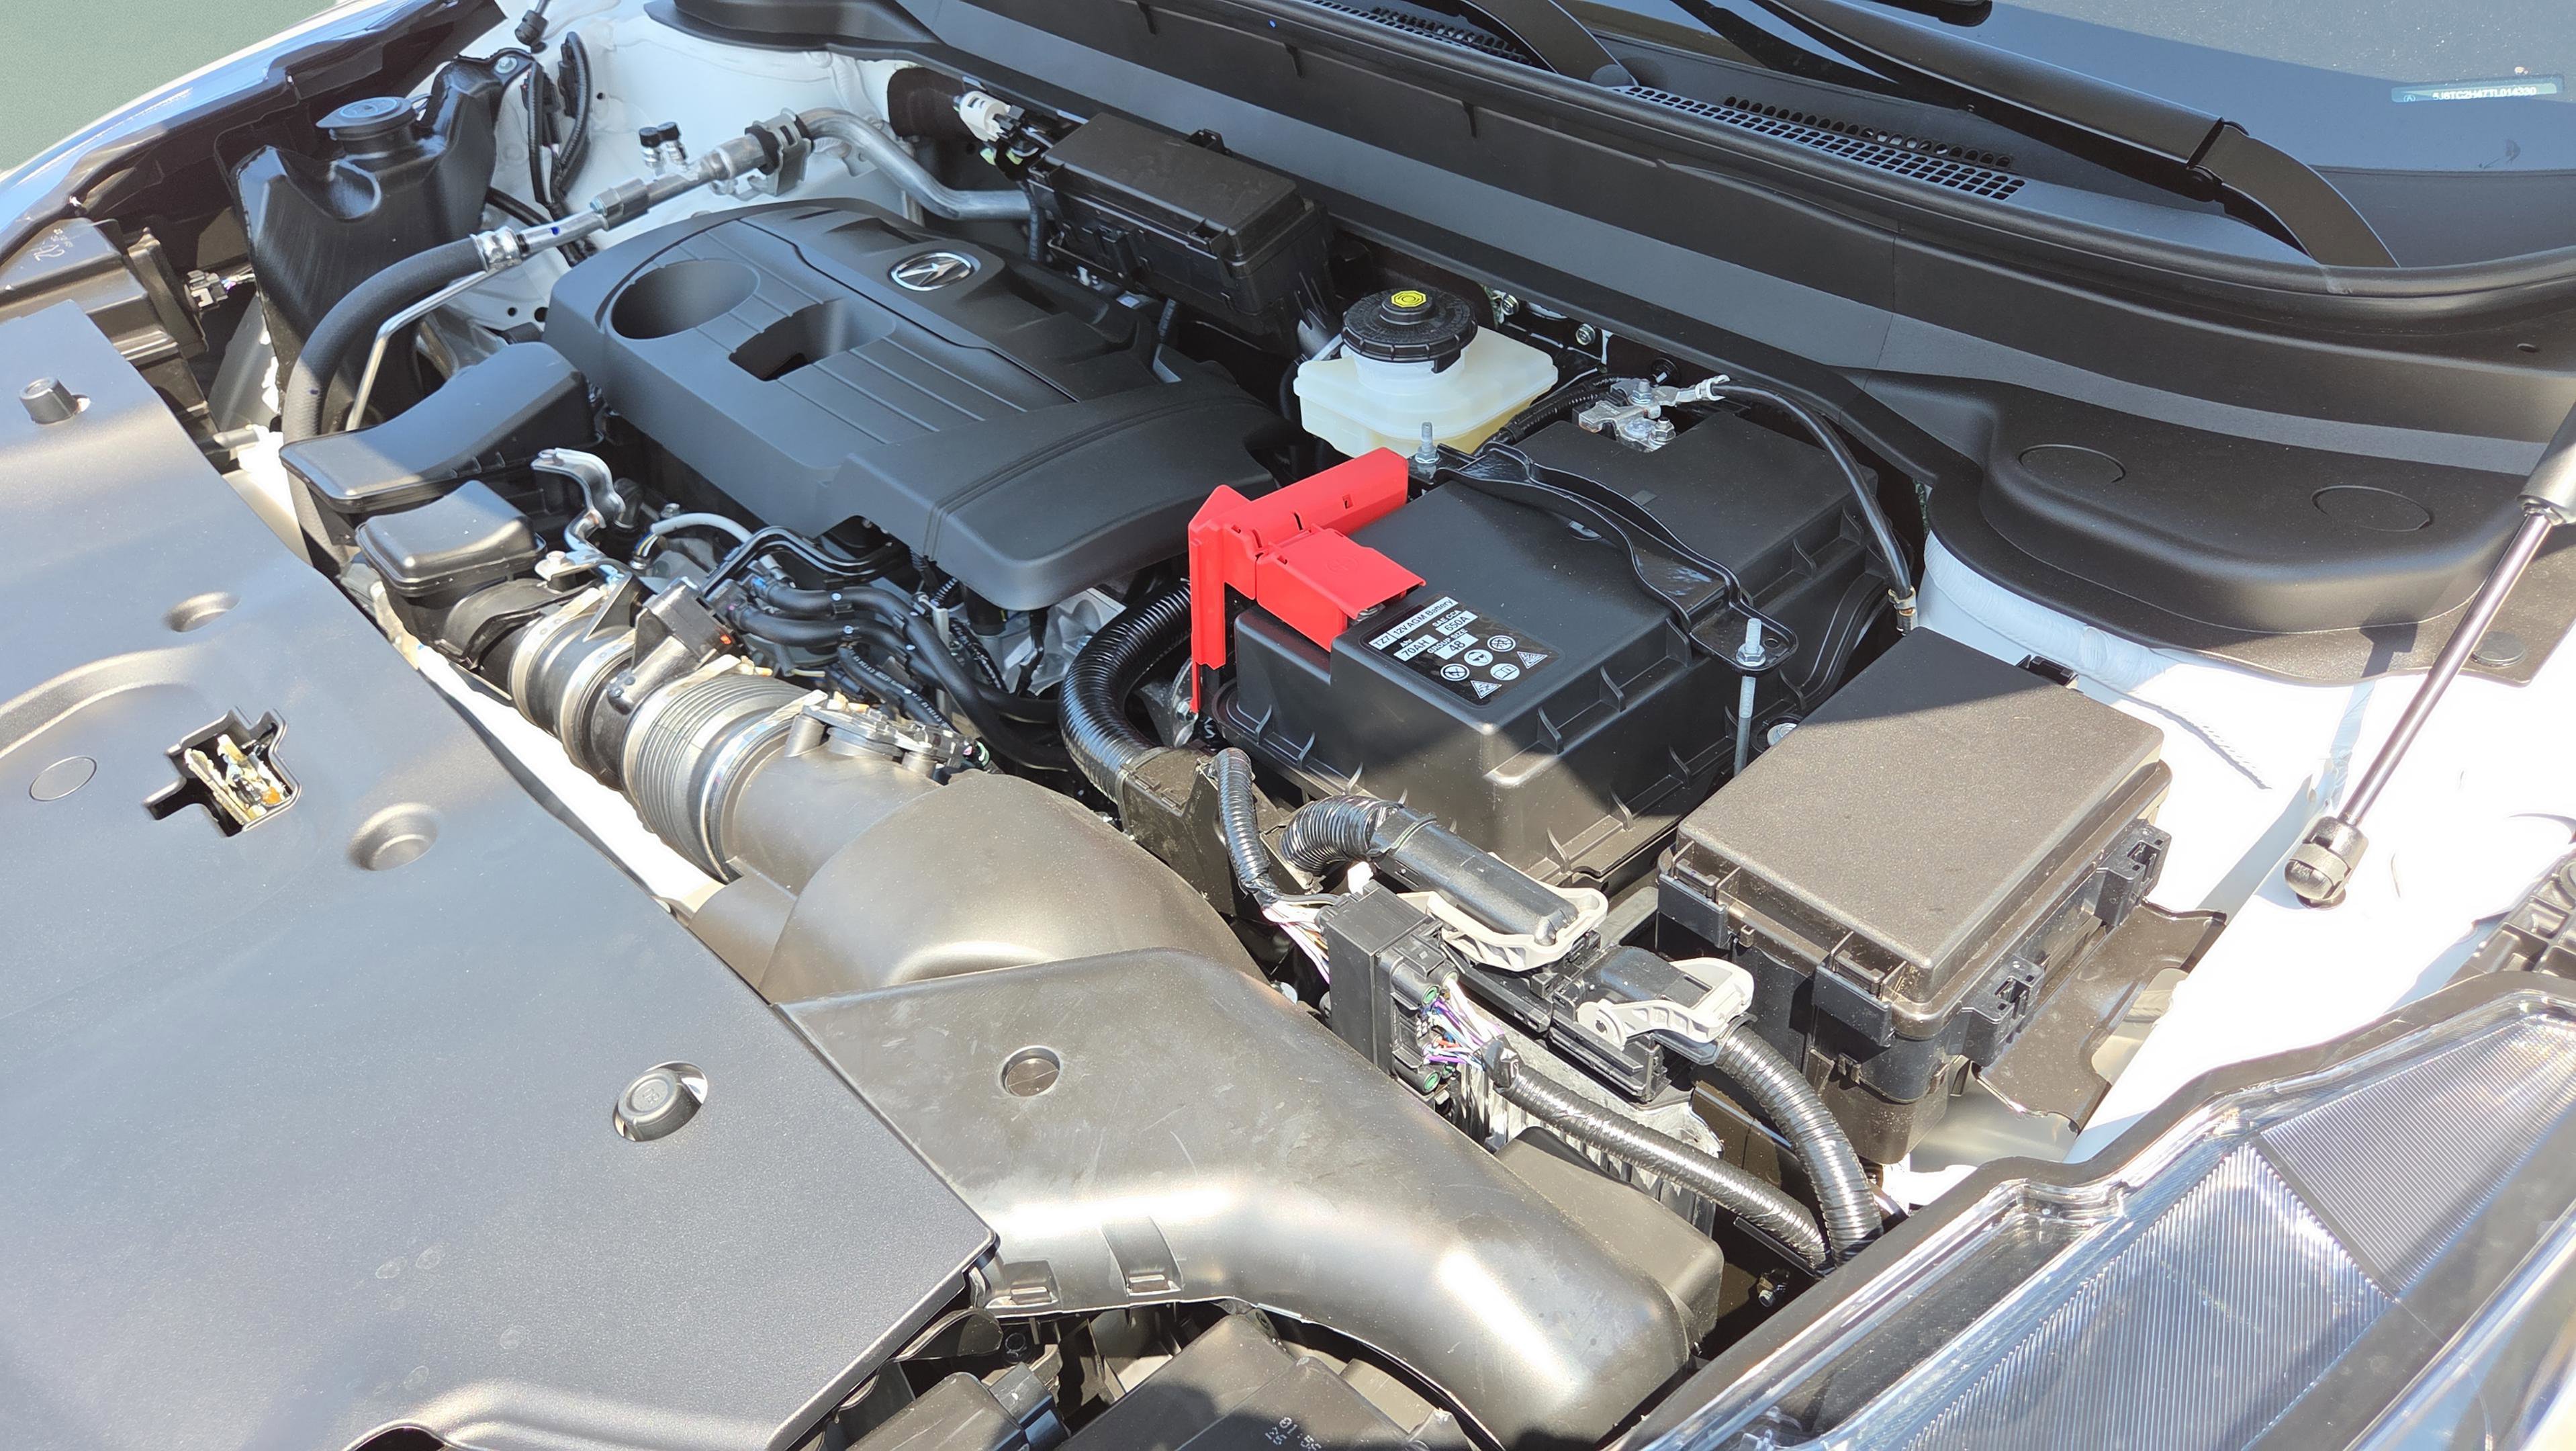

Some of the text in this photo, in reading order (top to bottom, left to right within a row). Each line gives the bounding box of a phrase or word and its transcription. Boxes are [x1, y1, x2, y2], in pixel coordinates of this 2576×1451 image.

[1373, 599, 1453, 646] TZ7 12V AGM Battery
[1432, 610, 1462, 627] SAE CCA
[1444, 616, 1470, 631] 650A
[1401, 640, 1430, 657] 70AH
[1427, 628, 1468, 654] GROUP SIZE
[1449, 640, 1465, 652] 48
